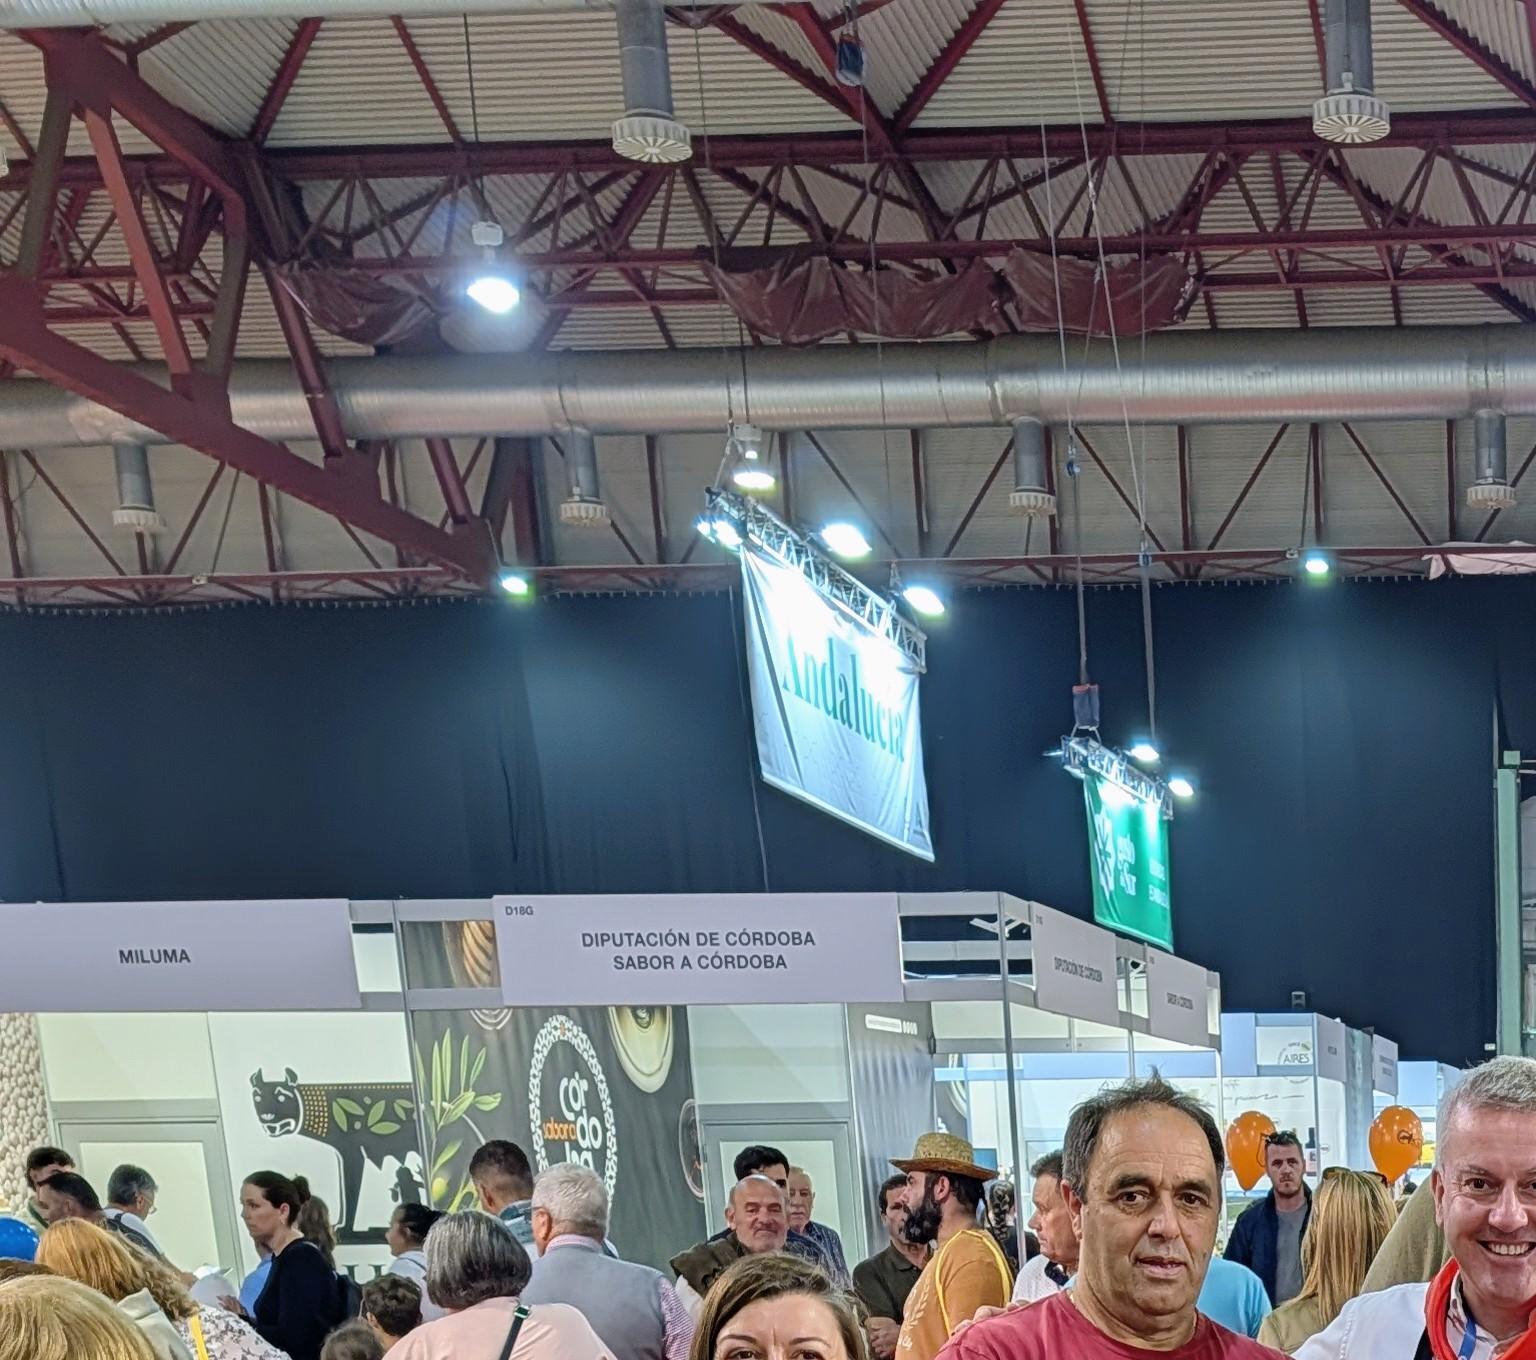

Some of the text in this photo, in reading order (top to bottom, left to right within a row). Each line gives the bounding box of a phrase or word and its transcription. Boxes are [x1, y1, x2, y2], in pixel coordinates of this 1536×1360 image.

[581, 928, 816, 947] DIPUTACIÓN DE CÓRDOBA
[118, 948, 191, 964] MILUMA
[613, 951, 788, 970] SABOR A CÓRDOBA
[1283, 1053, 1310, 1065] AIRES
